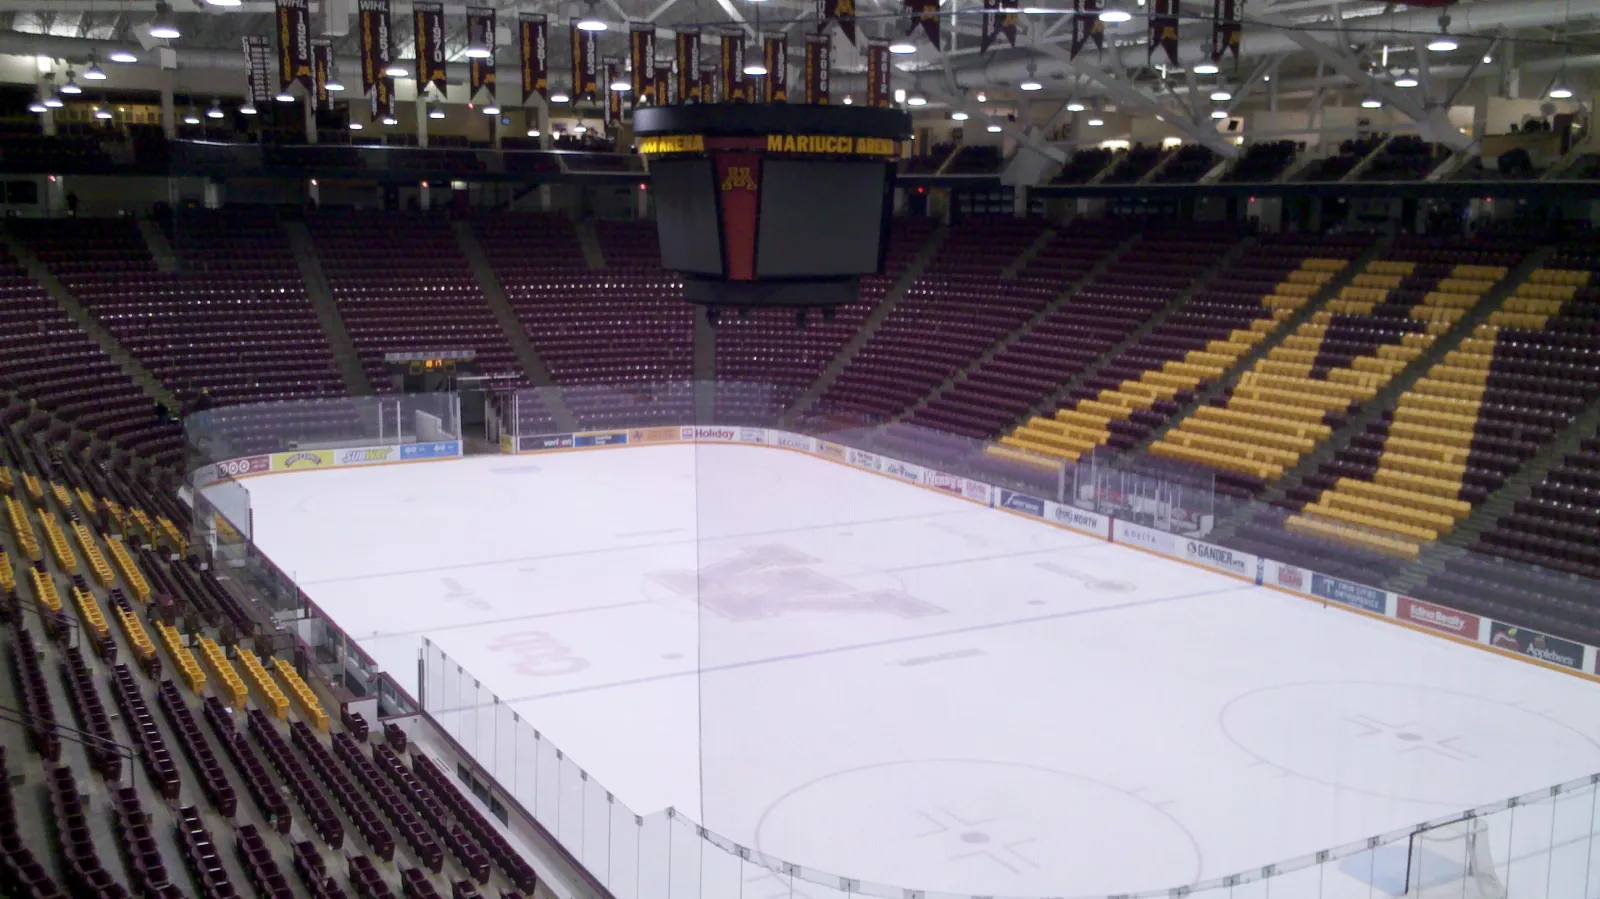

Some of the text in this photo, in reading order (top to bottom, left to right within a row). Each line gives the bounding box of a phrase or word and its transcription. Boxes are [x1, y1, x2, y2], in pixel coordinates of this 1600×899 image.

[360, 1, 389, 11] WIHL
[297, 11, 307, 60] 1953
[378, 14, 389, 62] 1954
[433, 15, 443, 63] 1970
[536, 25, 545, 72] 1981
[767, 134, 853, 153] MARIUCCI
[695, 428, 735, 440] Holiday
[342, 447, 393, 463] SUBWAY
[1197, 544, 1233, 565] GANDER
[1435, 611, 1465, 630] Realty
[1526, 642, 1574, 666] Applebee's
